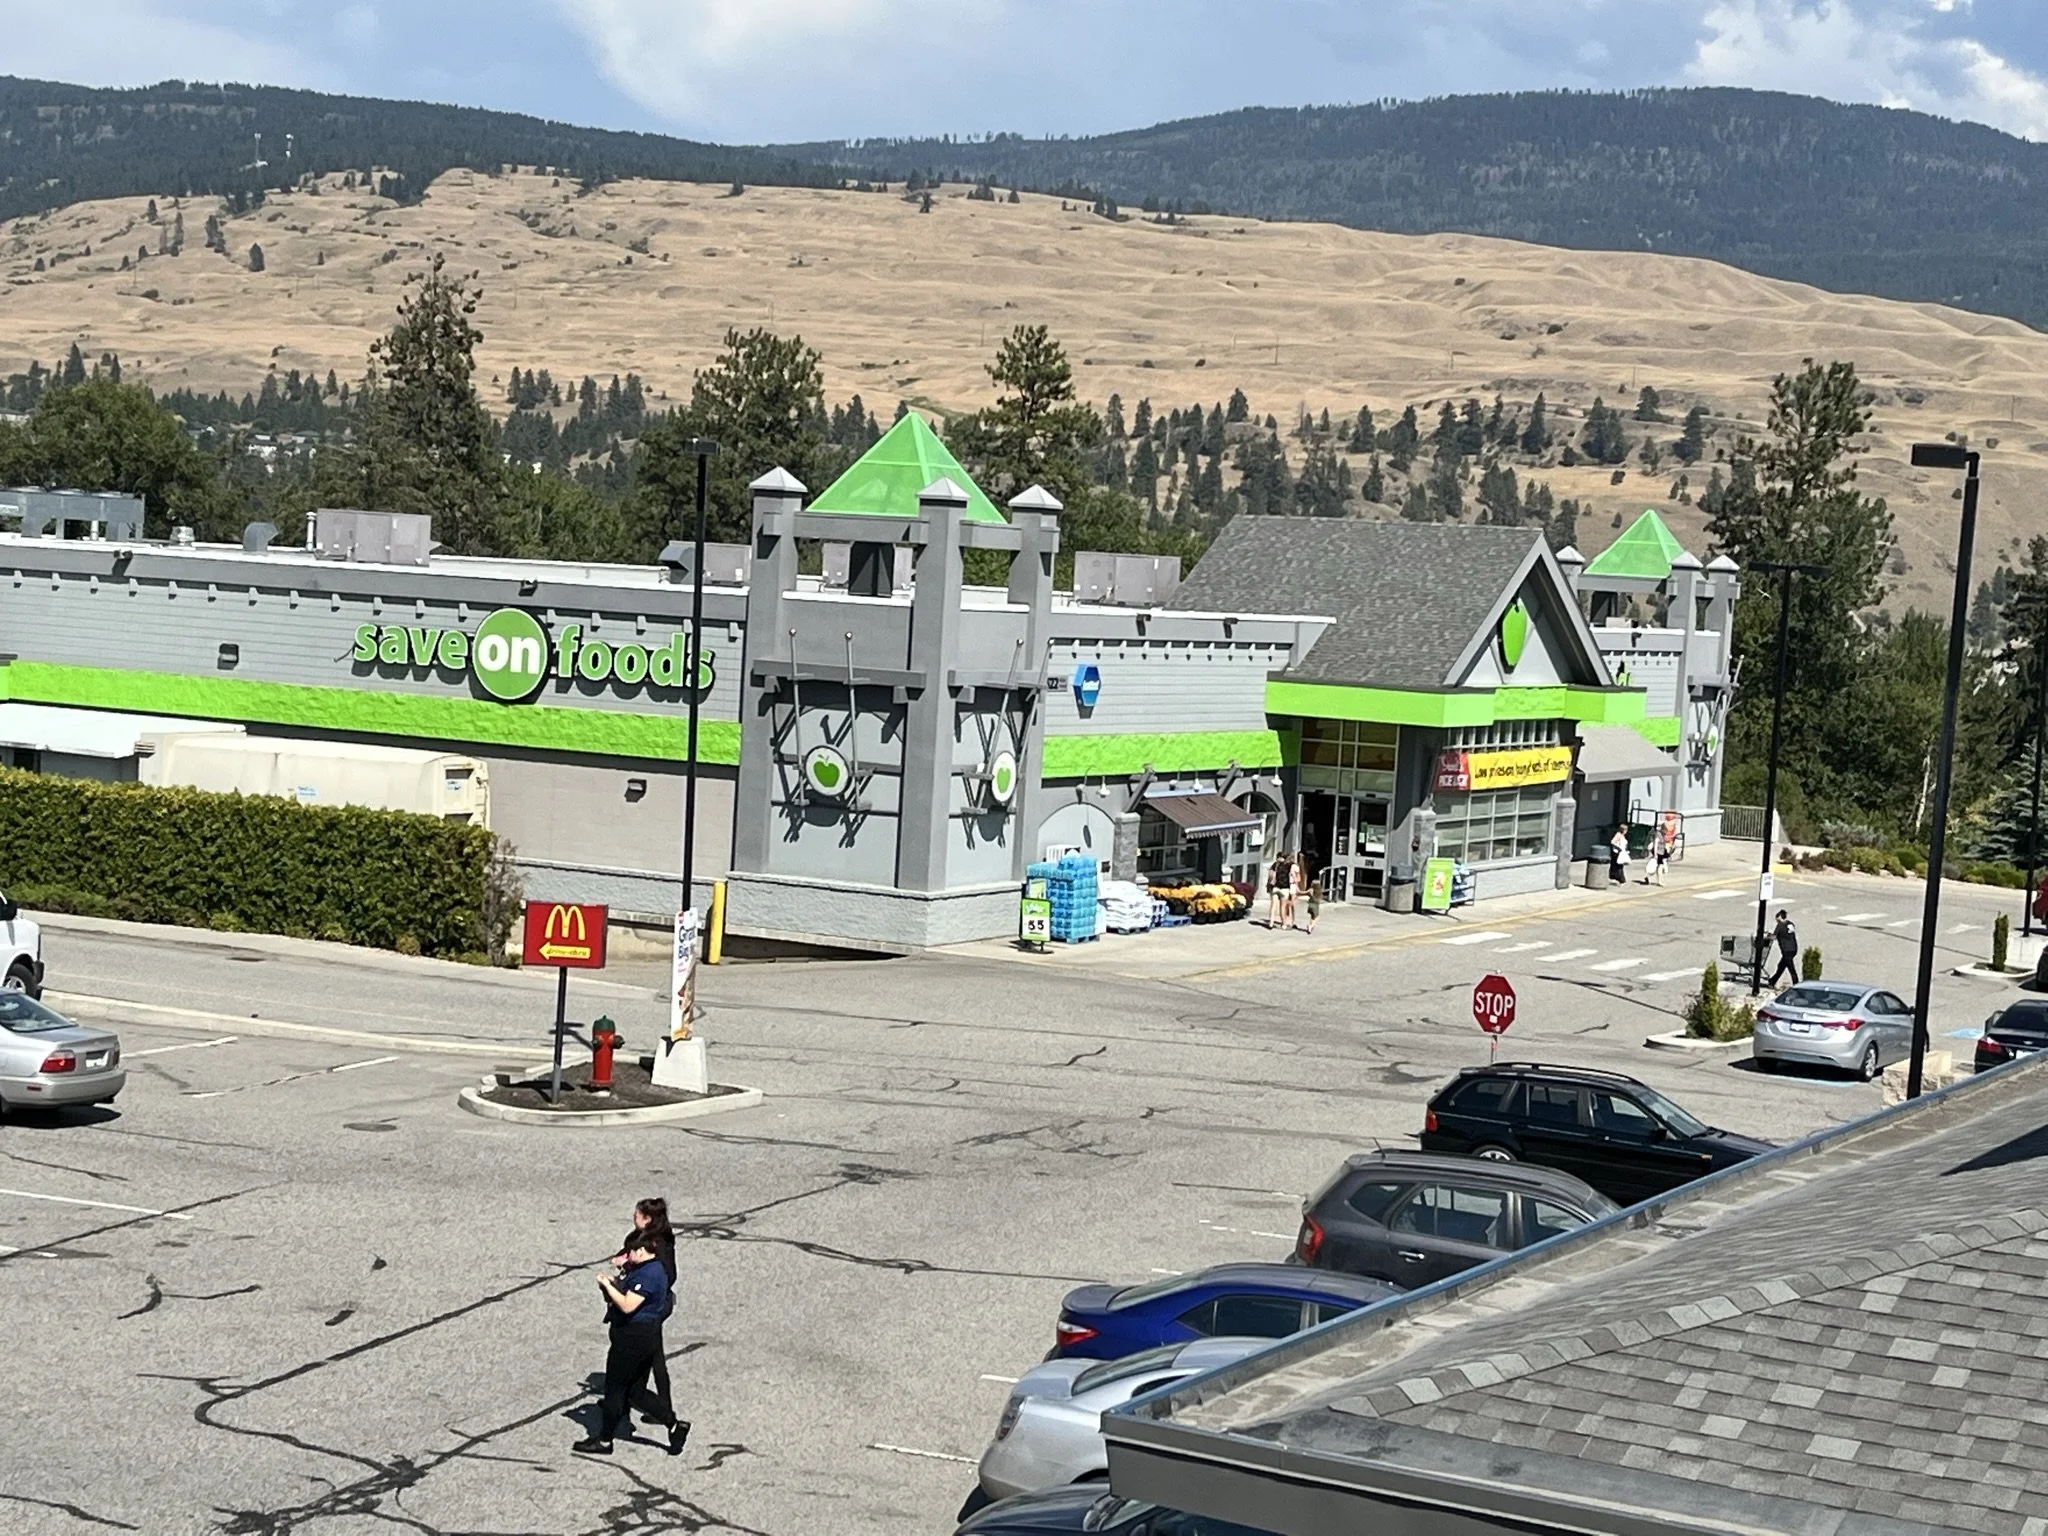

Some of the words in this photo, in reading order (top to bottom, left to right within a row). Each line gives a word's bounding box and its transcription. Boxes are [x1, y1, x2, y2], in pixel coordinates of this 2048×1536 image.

[354, 623, 469, 670] save
[477, 633, 541, 676] on
[1475, 992, 1514, 1017] STOP
